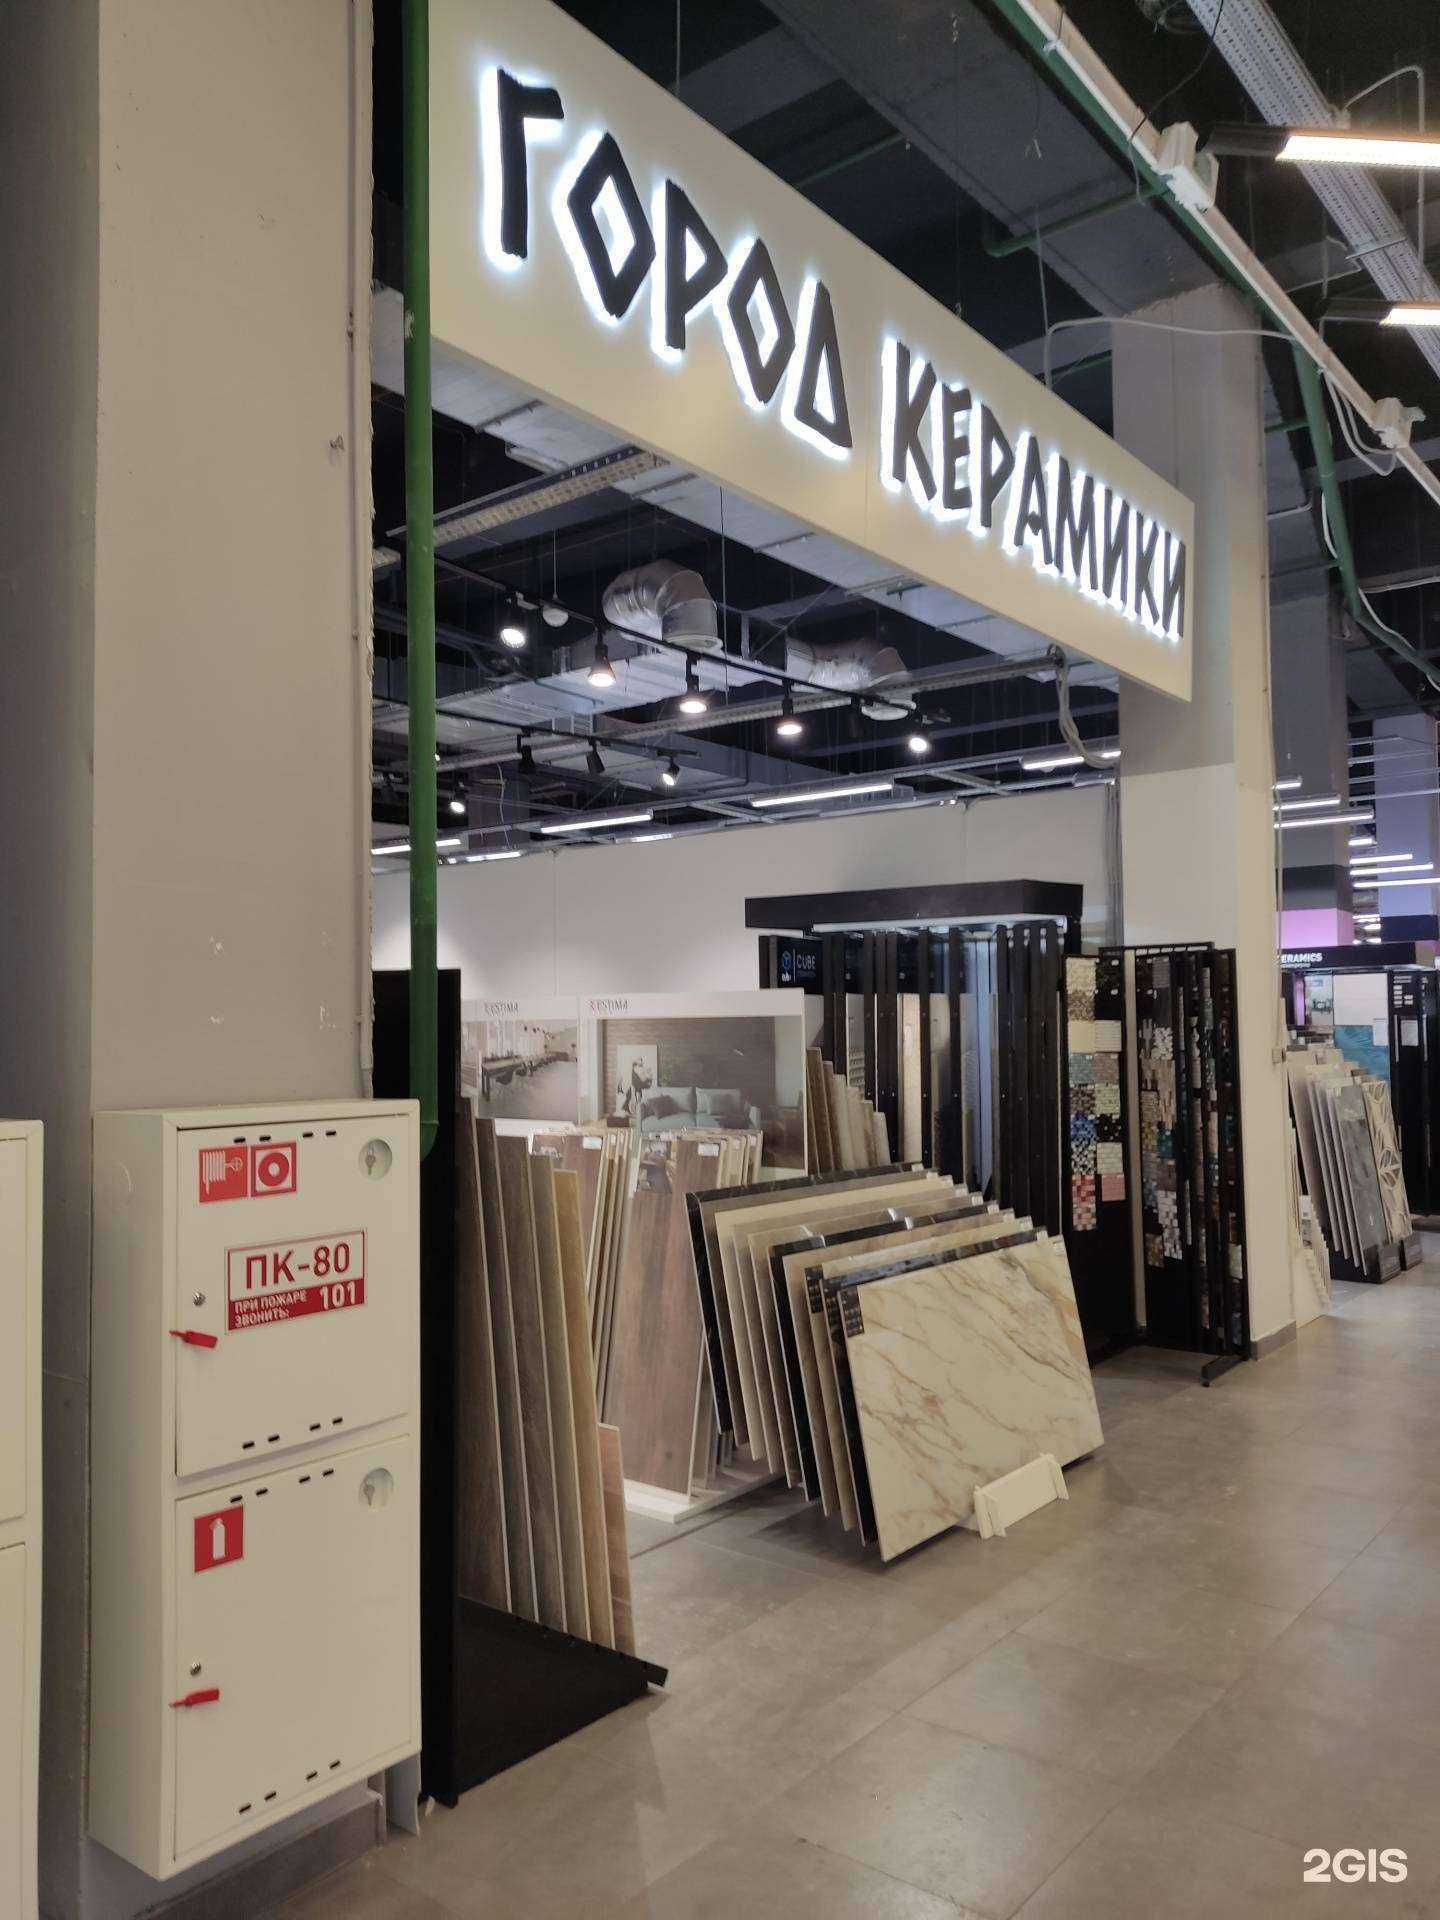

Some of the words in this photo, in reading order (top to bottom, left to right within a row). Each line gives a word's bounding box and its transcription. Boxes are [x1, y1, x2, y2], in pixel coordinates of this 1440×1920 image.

[489, 66, 853, 452] ГОРОД
[885, 337, 1187, 640] КЕРАМИКИ
[1279, 952, 1322, 963] ERAMICS
[246, 1242, 350, 1289] ПК-80
[235, 1299, 259, 1314] ПРИ
[260, 1289, 307, 1310] ПОЖАРЕ
[320, 1281, 356, 1310] 101
